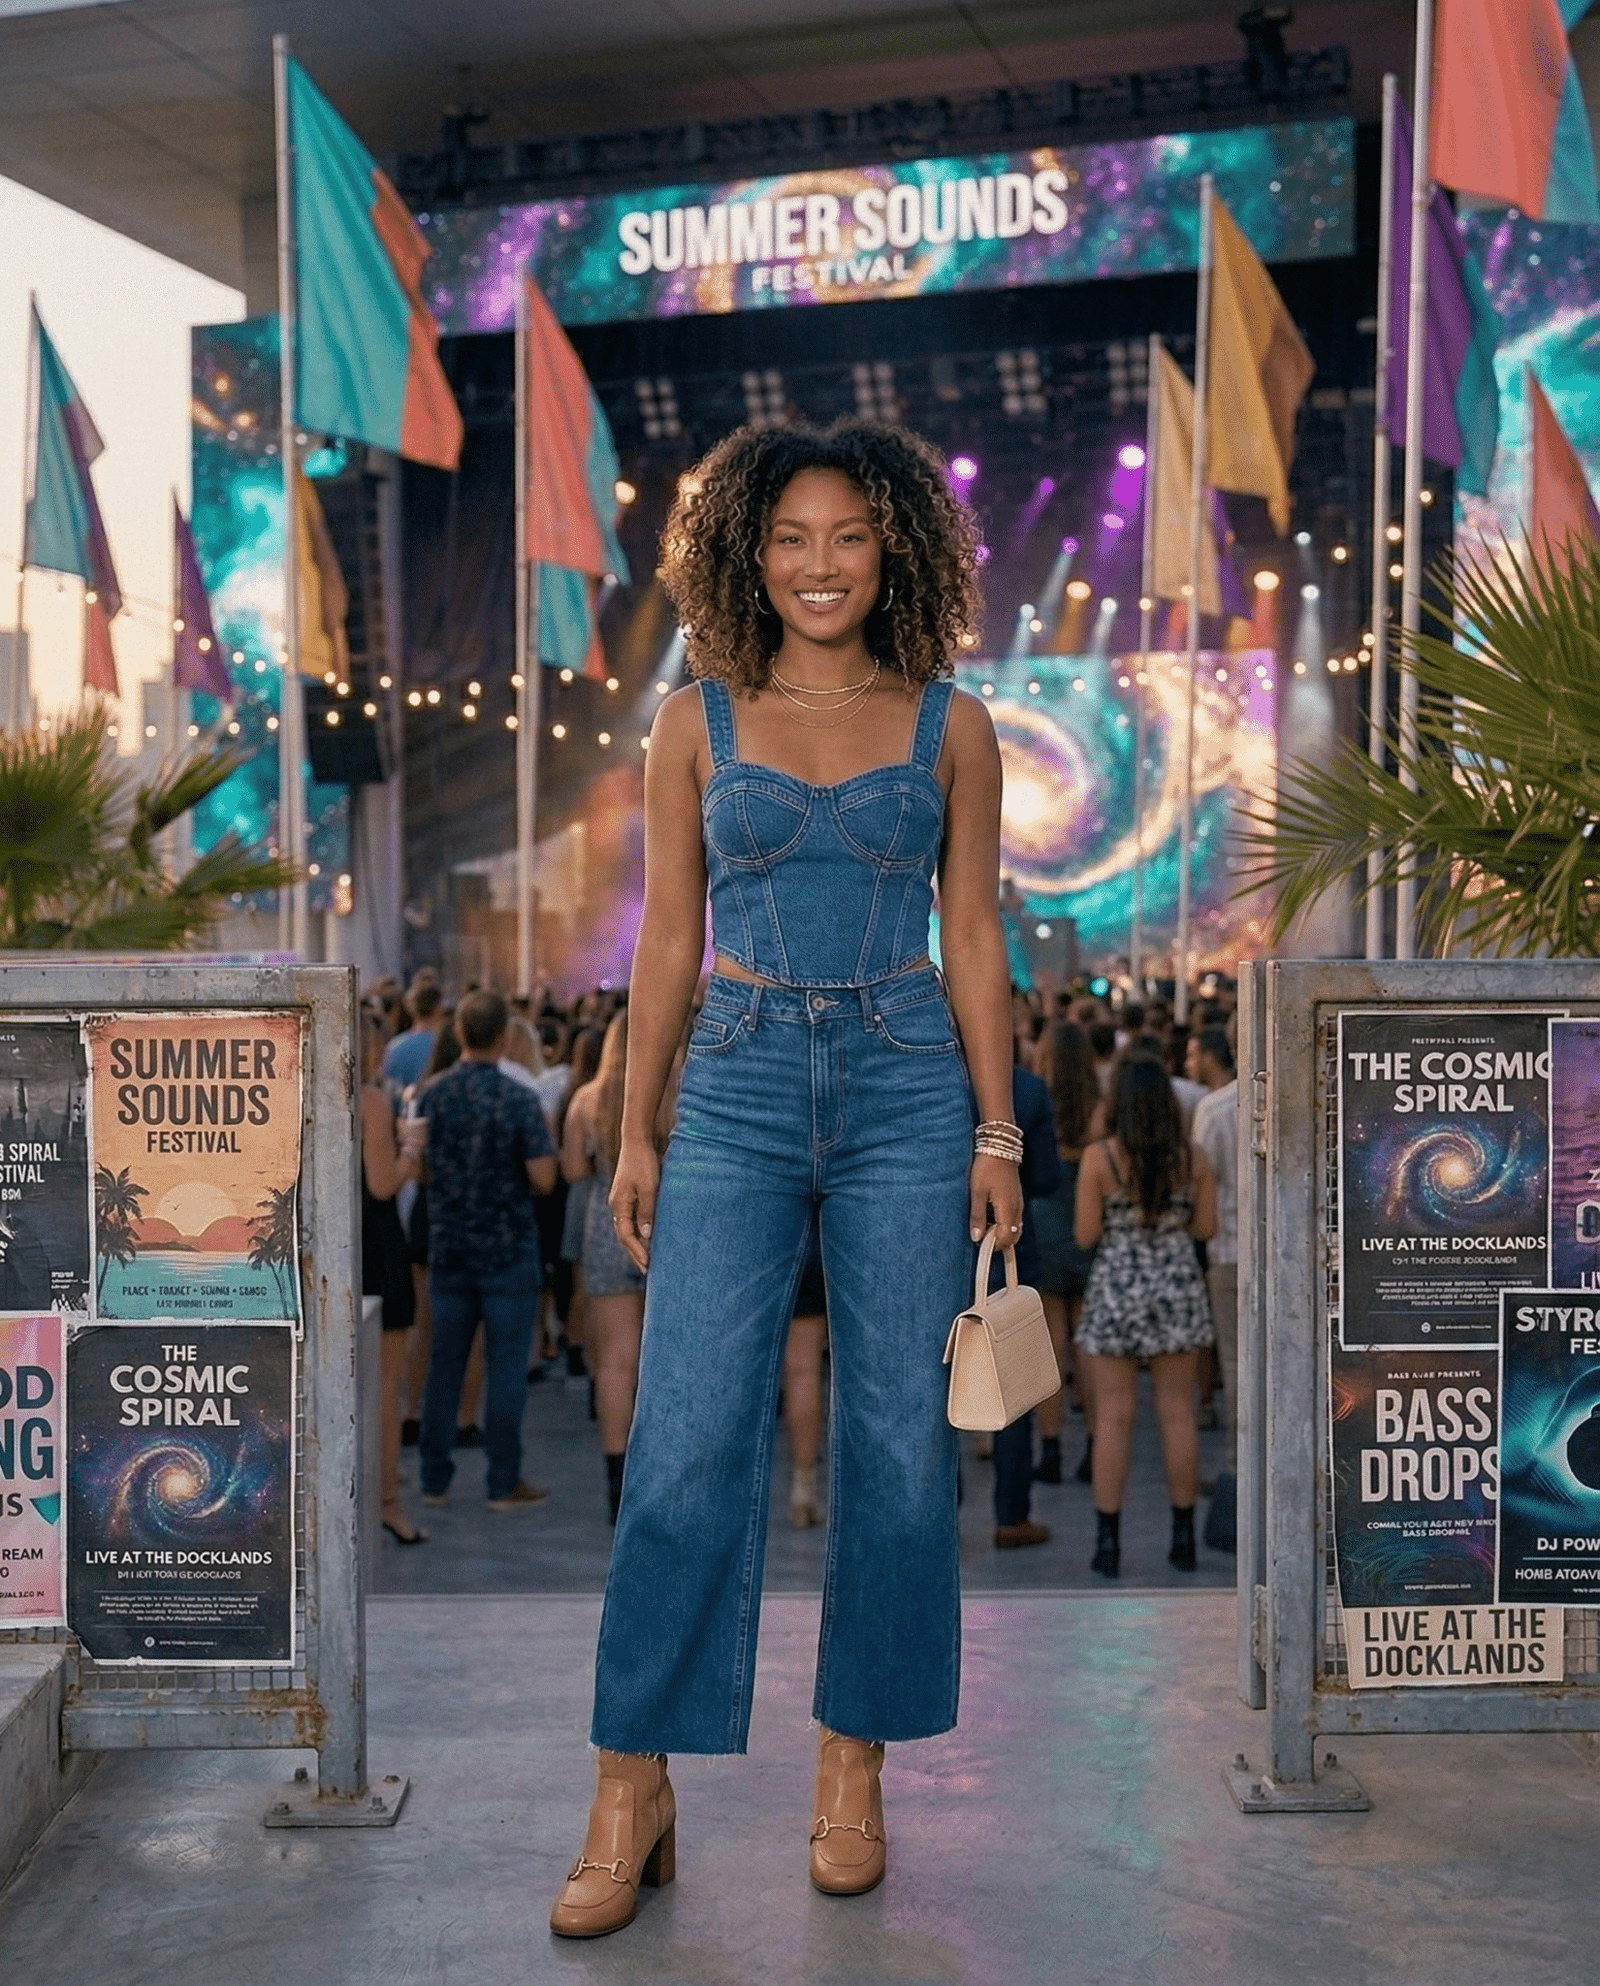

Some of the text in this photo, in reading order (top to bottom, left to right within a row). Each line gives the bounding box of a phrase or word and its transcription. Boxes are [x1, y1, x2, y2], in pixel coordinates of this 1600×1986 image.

[619, 169, 1069, 275] SUMMER SOUNDS
[752, 255, 912, 292] FESTIVAL
[110, 1038, 276, 1080] SUMMER
[1348, 1052, 1411, 1081] THE
[117, 1084, 270, 1126] SOUNDS
[1393, 1084, 1514, 1113] SPIRAL
[9, 1142, 61, 1162] SPIRAL
[146, 1130, 242, 1153] FESTIVAL
[1362, 1236, 1547, 1251] LIVE AT THE DOCKLANDS
[1515, 1306, 1600, 1333] STYR
[161, 1345, 197, 1361] THE
[1571, 1338, 1600, 1354] FE
[109, 1364, 250, 1394] COSMIC
[118, 1398, 240, 1426] SPIRAL
[1376, 1387, 1492, 1443] BASS
[1361, 1446, 1500, 1503] DROPS
[2, 1548, 43, 1560] REAM
[86, 1551, 273, 1564] LIVE AT THE DOCKLANDS
[1537, 1537, 1600, 1551] DJ POW
[1364, 1608, 1546, 1642] LIVE AT THE
[1364, 1643, 1545, 1678] DOCKLANDS
